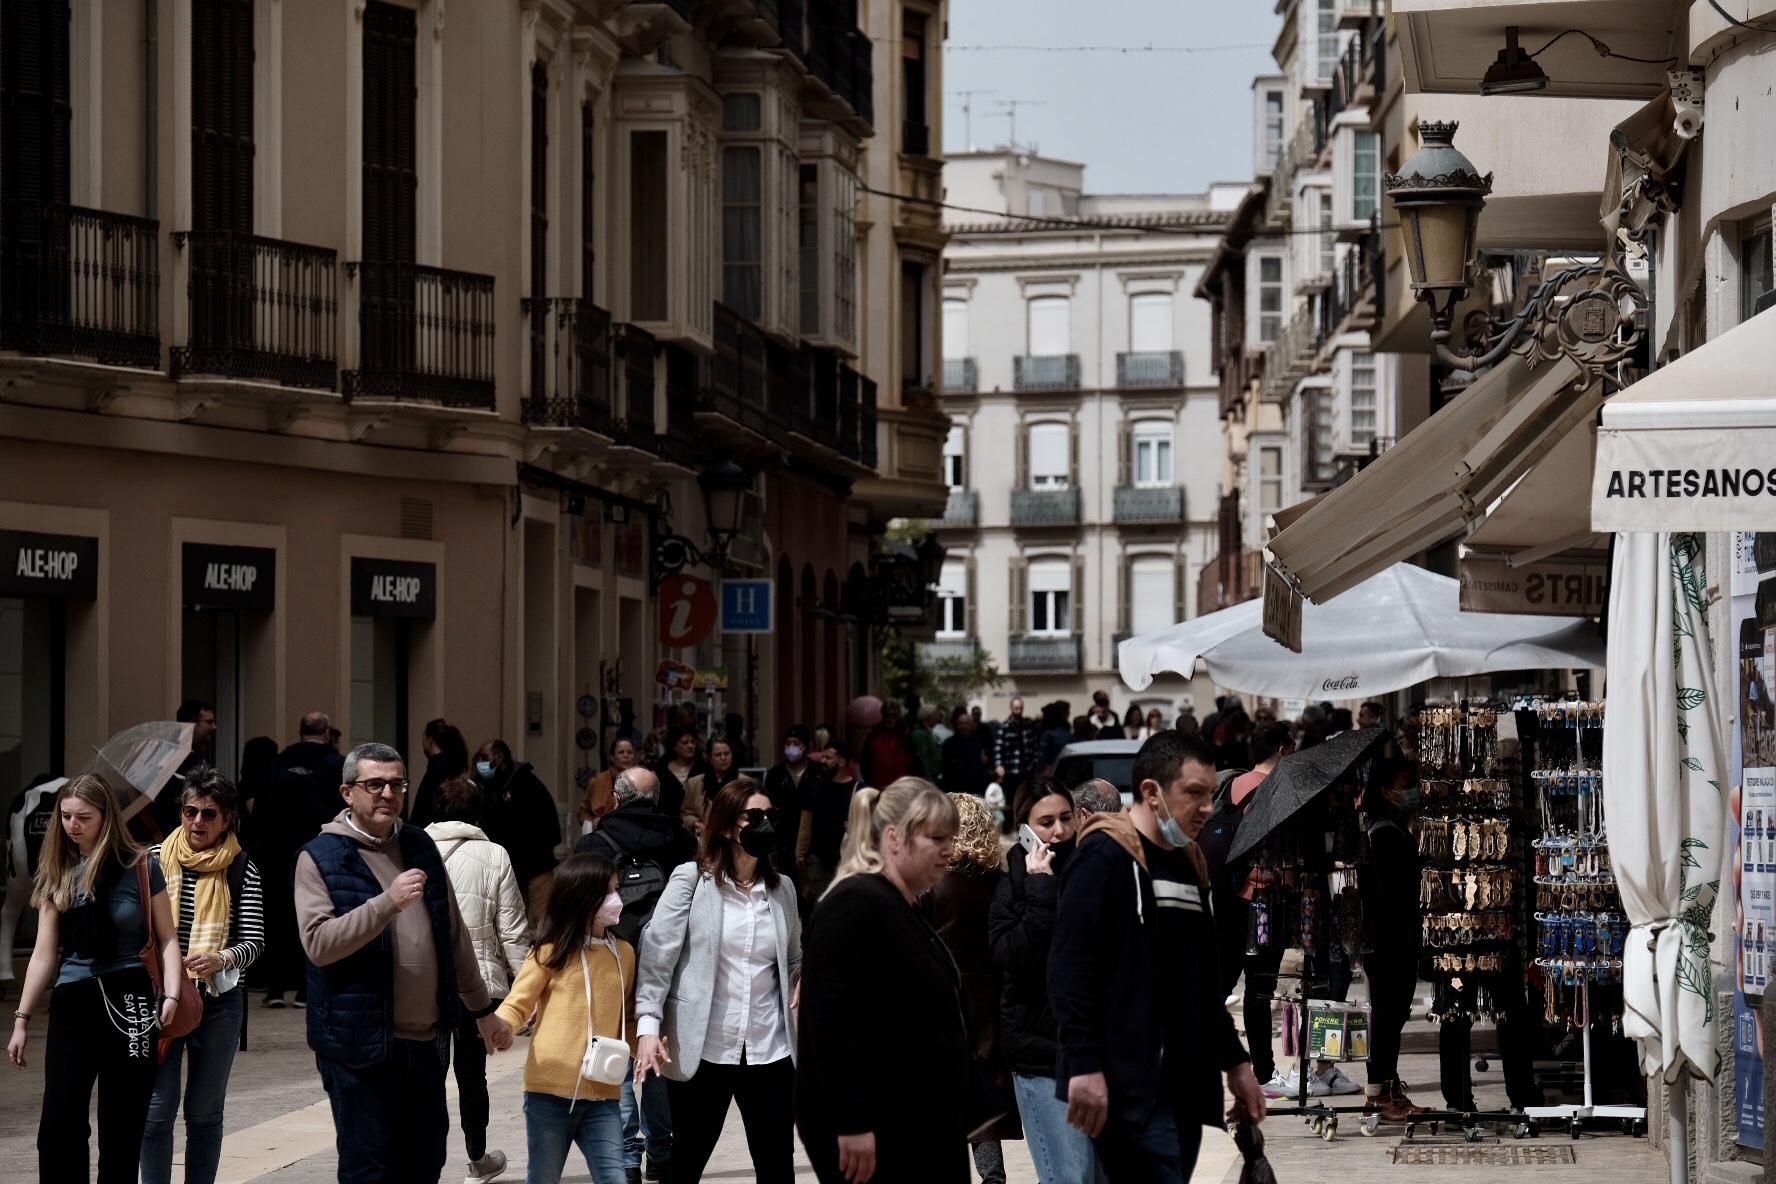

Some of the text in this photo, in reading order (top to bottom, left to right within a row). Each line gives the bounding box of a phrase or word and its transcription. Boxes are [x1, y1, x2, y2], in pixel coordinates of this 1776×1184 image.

[1607, 469, 1776, 498] ARTESANOS
[16, 547, 79, 580] ALE-HOP
[204, 562, 257, 592] ALE-HOP
[370, 575, 421, 604] ALE-HOP
[735, 587, 756, 614] H
[123, 993, 136, 1014] SAY
[138, 1002, 150, 1031] LOVE
[1314, 1016, 1340, 1024] PONCHO
[128, 1028, 139, 1058] BACK
[141, 1034, 150, 1058] YOU
